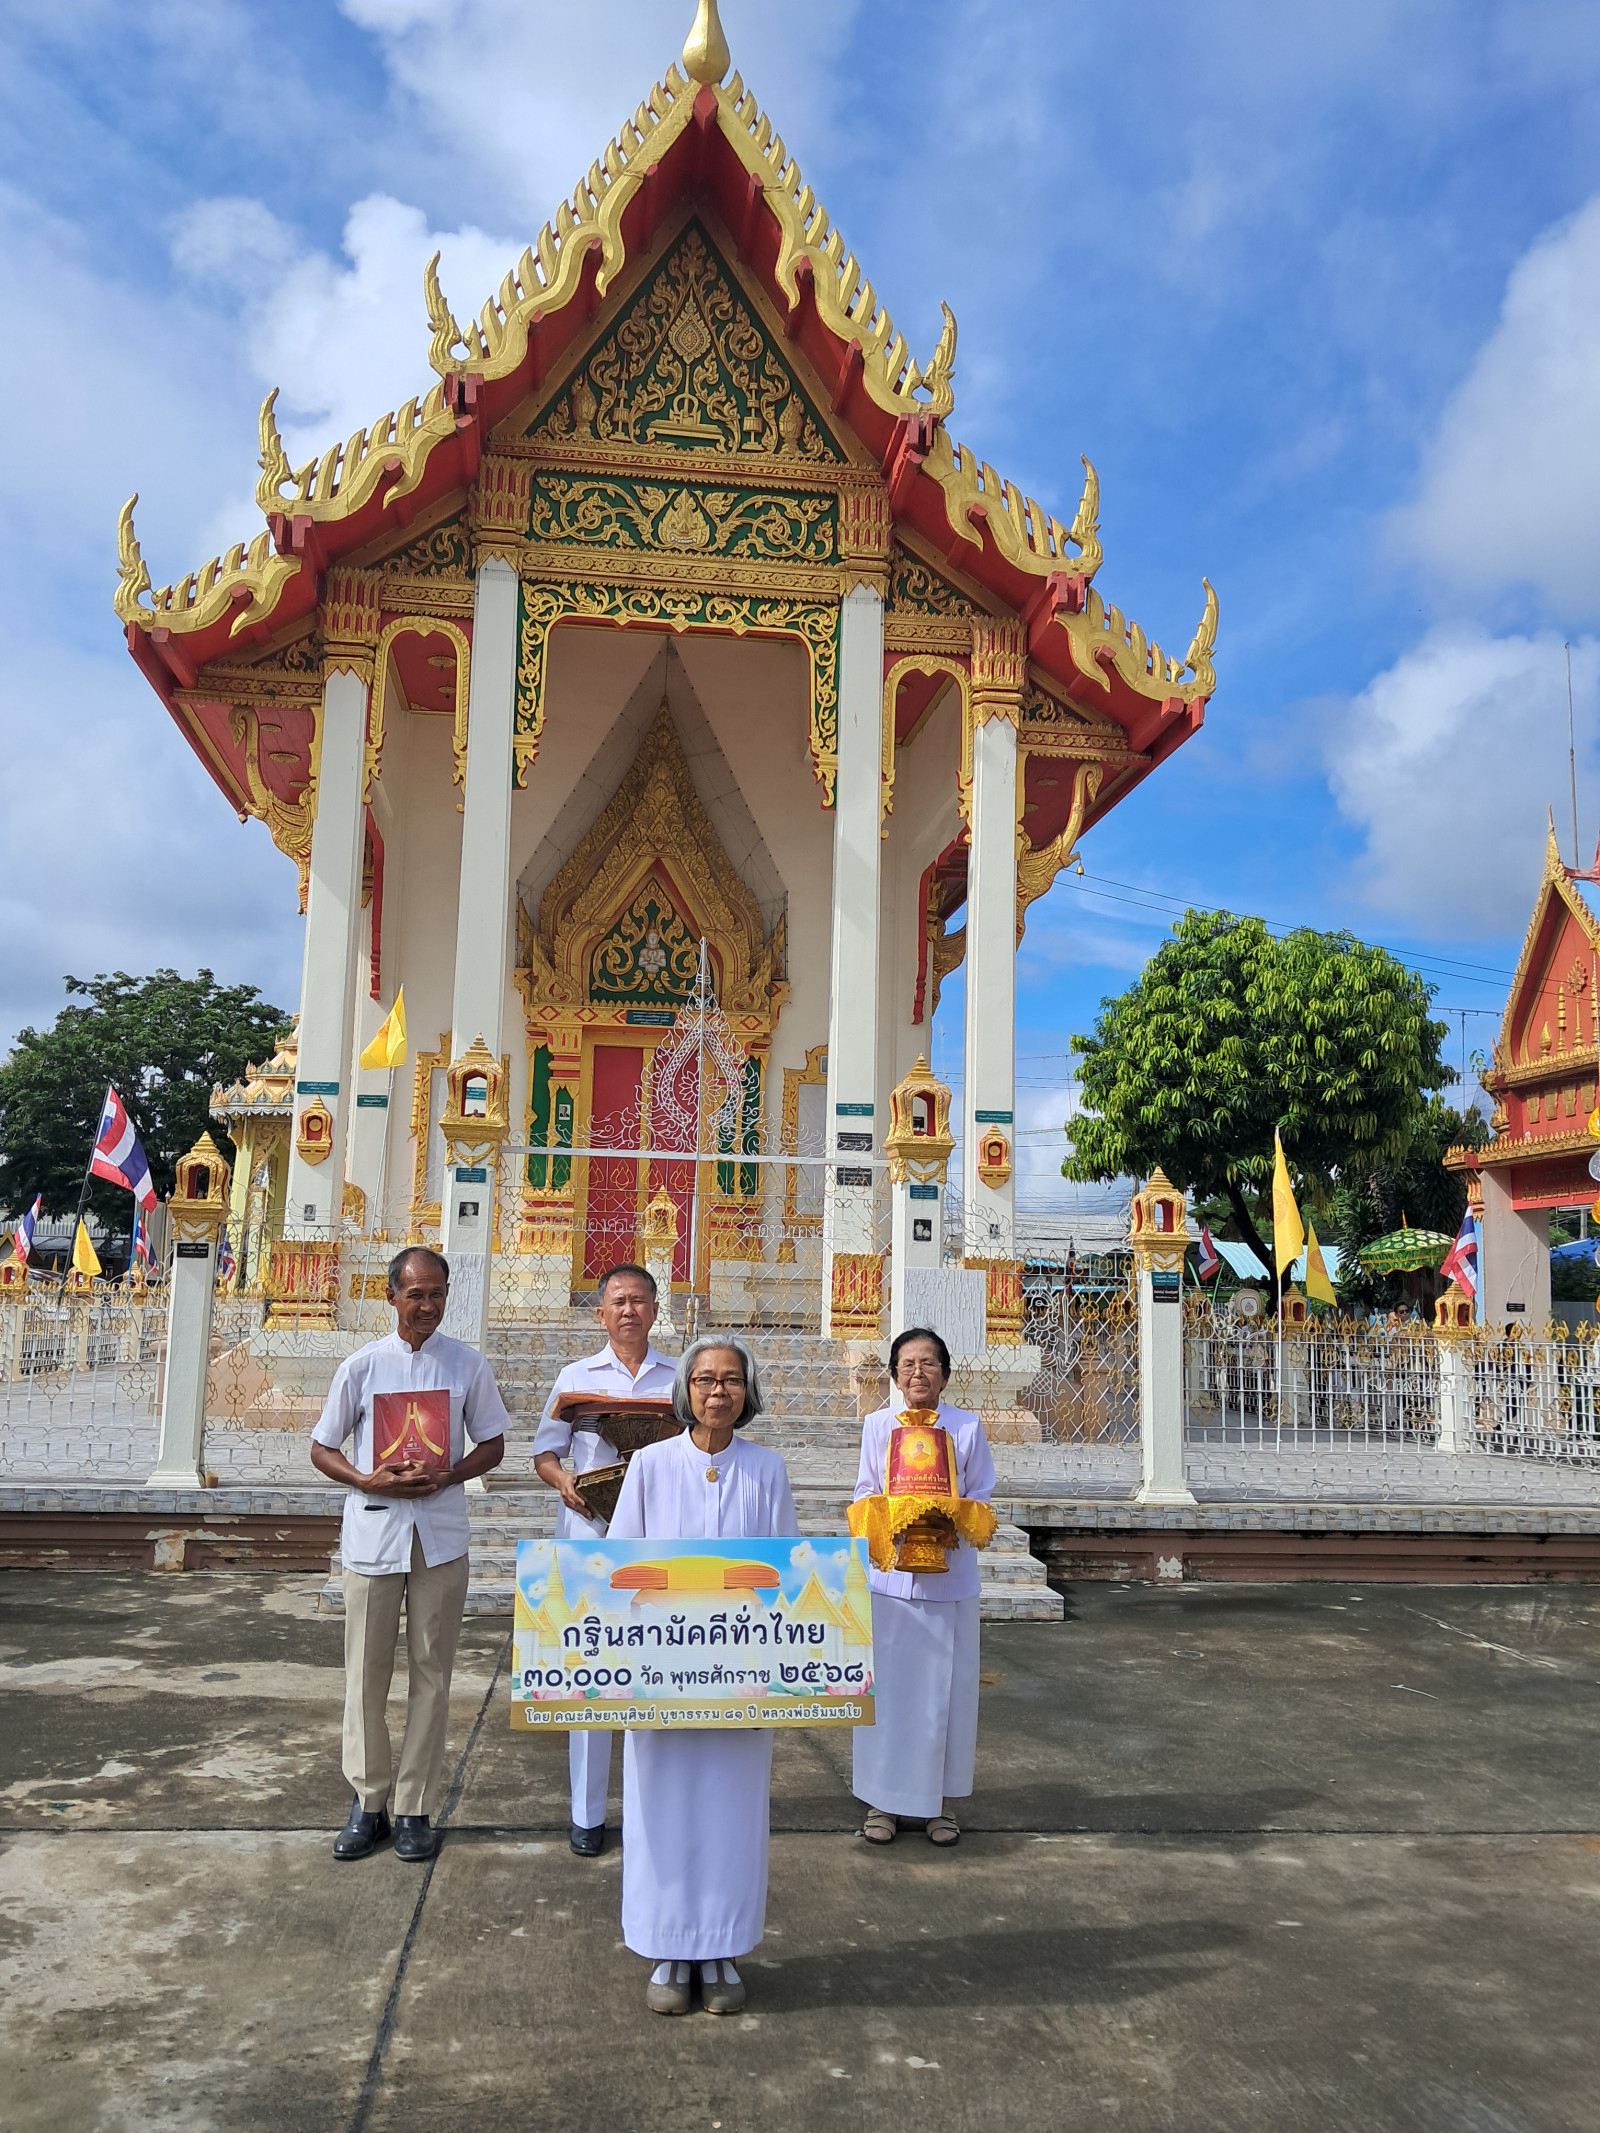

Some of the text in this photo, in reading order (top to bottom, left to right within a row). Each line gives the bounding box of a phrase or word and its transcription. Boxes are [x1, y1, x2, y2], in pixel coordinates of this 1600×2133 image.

[563, 1605, 825, 1656] กฐินสามัคคีทั่วไทย
[524, 1661, 864, 1692] ๓๐,๐๐๐ วัด พุทธศักราช ๒๕๖๘
[526, 1703, 861, 1725] โดย คณะศิษยานุศิษย์ บูชาธรรม ๘๑ ปี หลวงพ่อธัมมชโย
